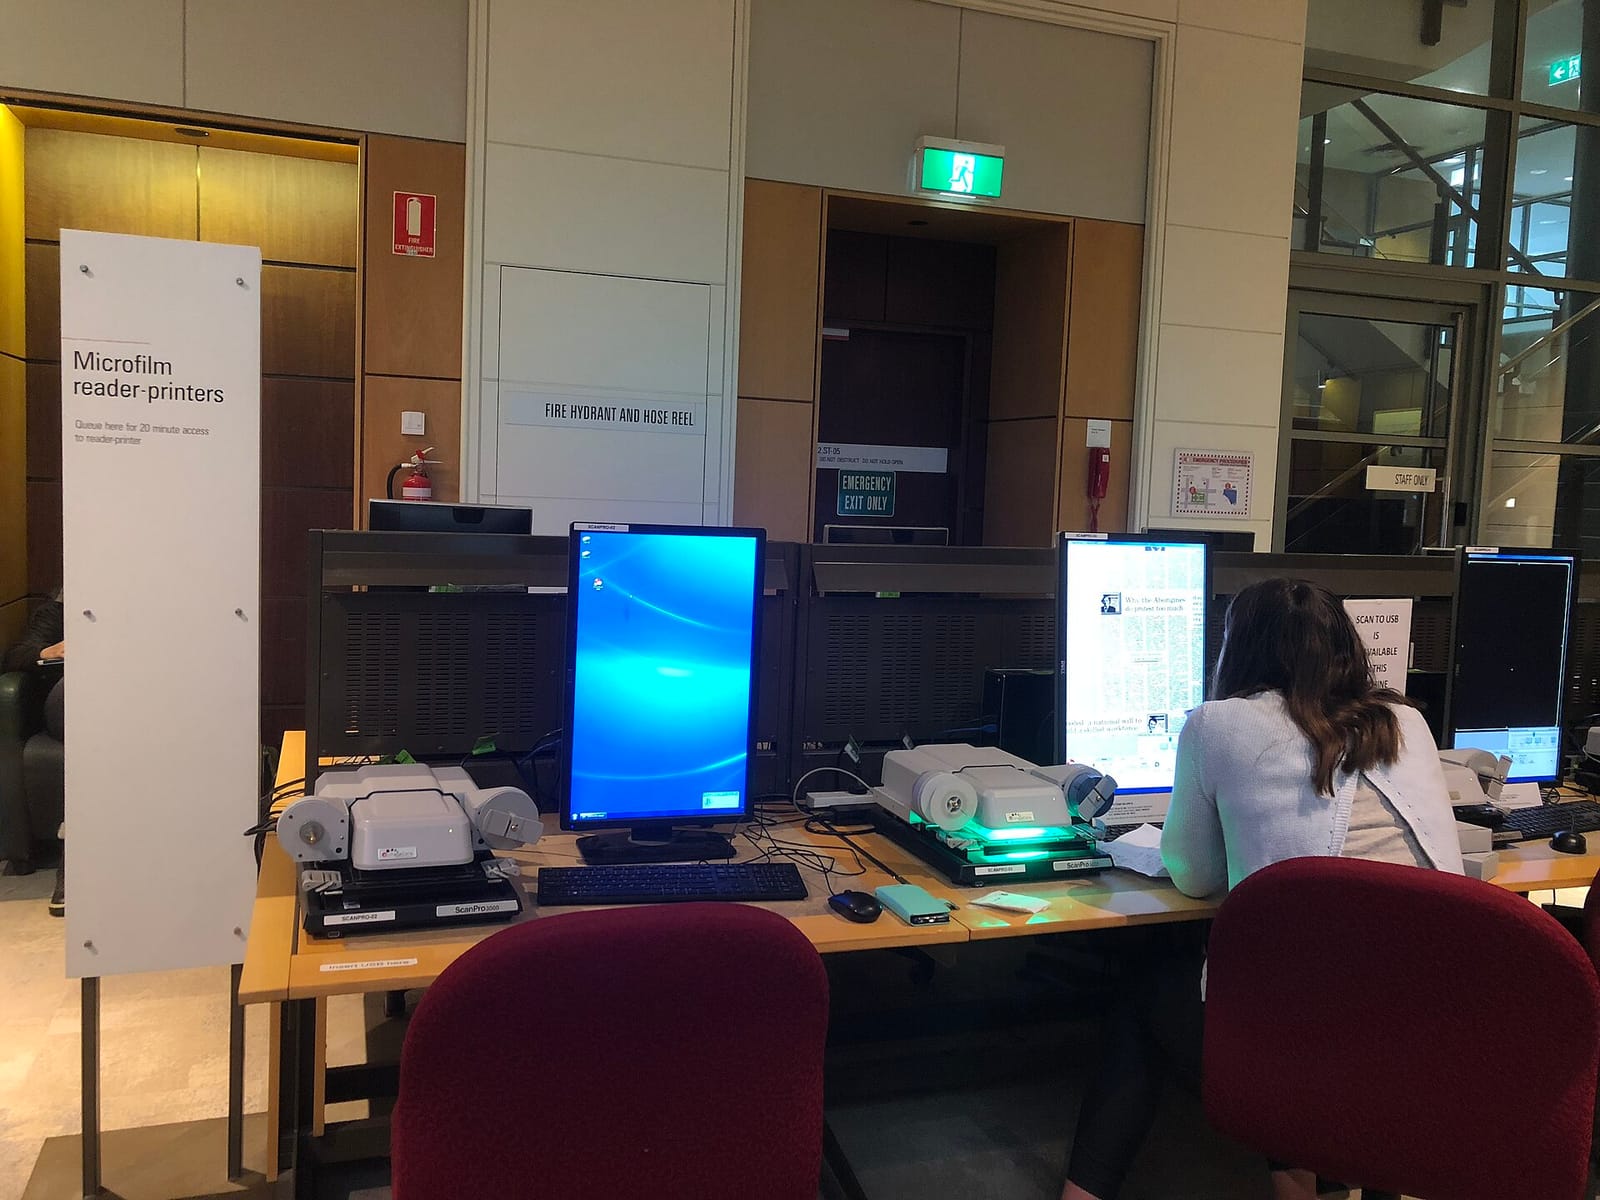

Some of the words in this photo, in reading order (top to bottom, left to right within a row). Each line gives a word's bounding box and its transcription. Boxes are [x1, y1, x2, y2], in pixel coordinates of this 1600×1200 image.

[74, 350, 172, 375] Microfilm
[74, 378, 224, 403] reader-printers
[545, 403, 567, 418] FIRE
[570, 404, 617, 421] HYDRANT
[619, 408, 640, 423] AND
[643, 409, 668, 425] HOSE
[671, 411, 694, 426] REEL
[75, 419, 103, 430] Queue
[105, 421, 124, 431] here
[126, 422, 137, 432] for
[140, 423, 151, 433] 20
[152, 424, 180, 434] minute
[182, 426, 210, 436] access
[75, 434, 84, 442] to
[86, 434, 142, 445] reader-printer
[842, 474, 892, 491] EMERGENCY
[1395, 473, 1412, 485] STAFF
[1413, 474, 1428, 486] ONLY
[844, 495, 864, 510] EXIT
[866, 495, 888, 511] ONLY
[1356, 615, 1375, 624] SCAN
[1375, 615, 1385, 623] TO
[1385, 614, 1399, 623] USB
[1373, 631, 1380, 640] IS
[1372, 663, 1387, 673] THIS
[1067, 862, 1090, 870] ScanPro
